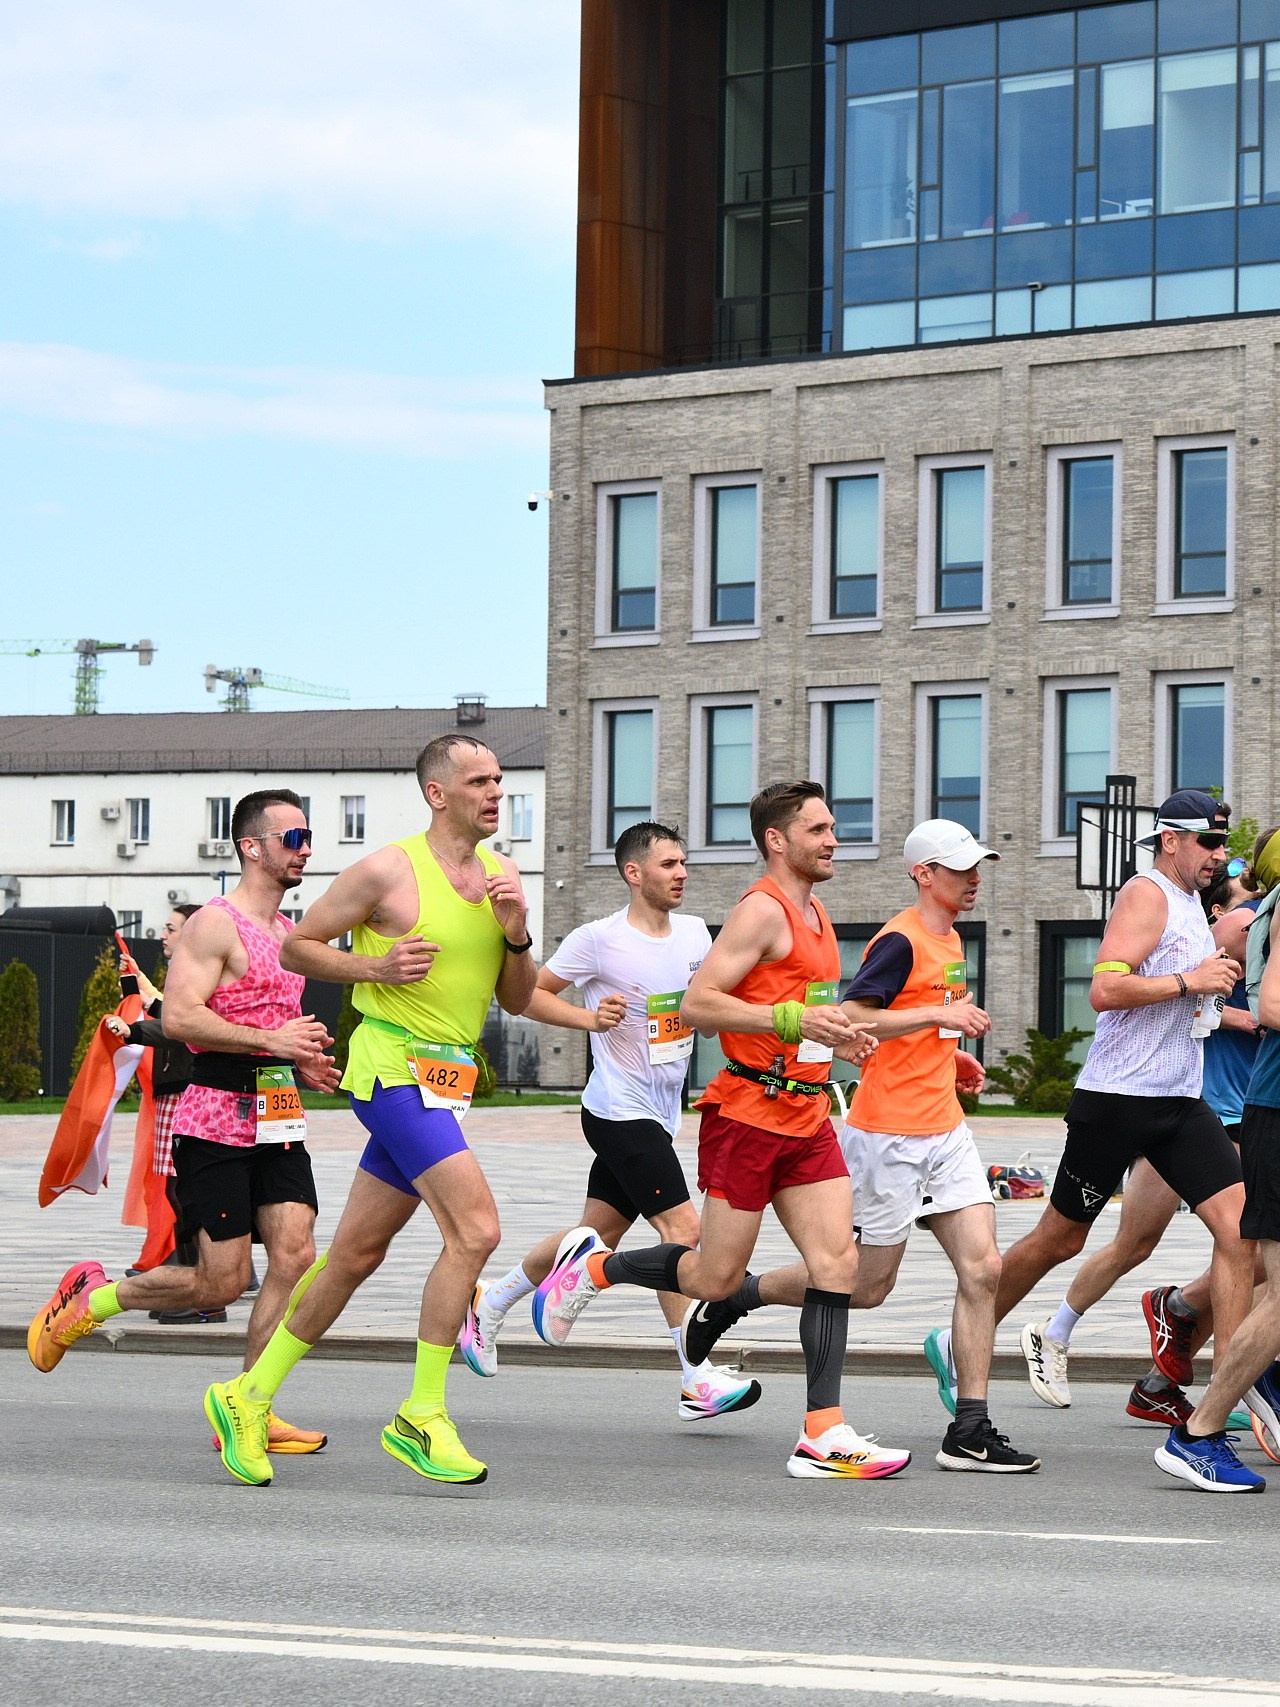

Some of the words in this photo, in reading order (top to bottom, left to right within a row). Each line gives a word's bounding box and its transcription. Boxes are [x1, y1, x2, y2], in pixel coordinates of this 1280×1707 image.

[650, 1025, 657, 1033] B
[426, 1067, 459, 1088] 482
[258, 1101, 265, 1110] B
[272, 1093, 300, 1111] 3523
